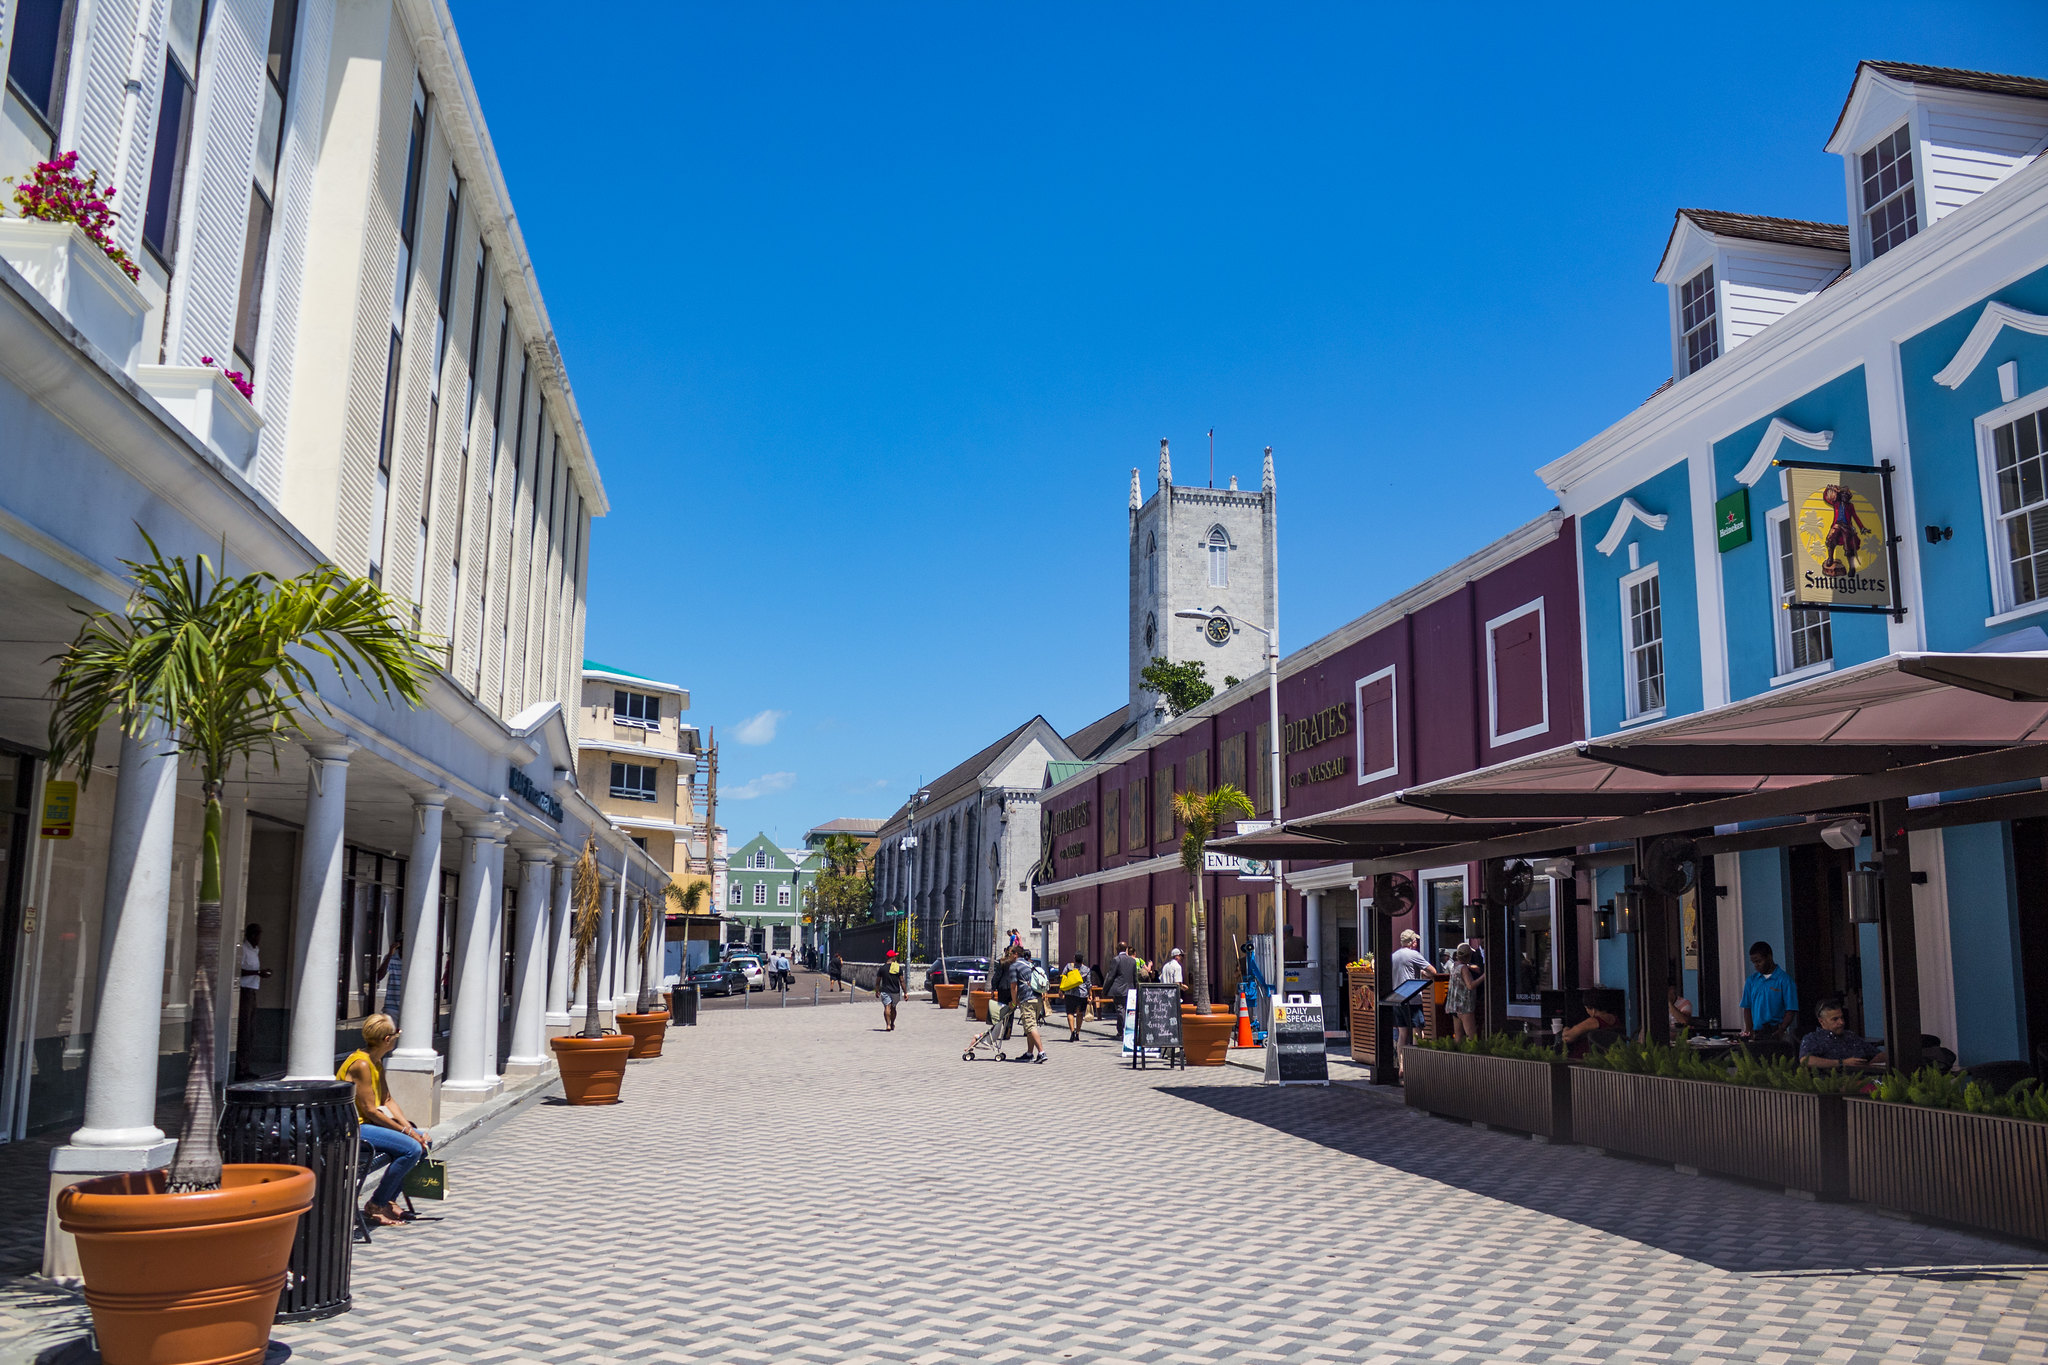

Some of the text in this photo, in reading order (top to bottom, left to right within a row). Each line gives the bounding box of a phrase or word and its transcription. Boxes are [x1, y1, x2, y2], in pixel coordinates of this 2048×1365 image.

[1719, 521, 1744, 537] Heineken
[1805, 570, 1886, 594] Smugglers
[1285, 702, 1347, 755] PIRATES
[1308, 756, 1344, 784] NASSAU
[1055, 800, 1088, 836] PIRATES
[1286, 1007, 1308, 1015] DAILY
[1286, 1014, 1322, 1023] SPECIALS
